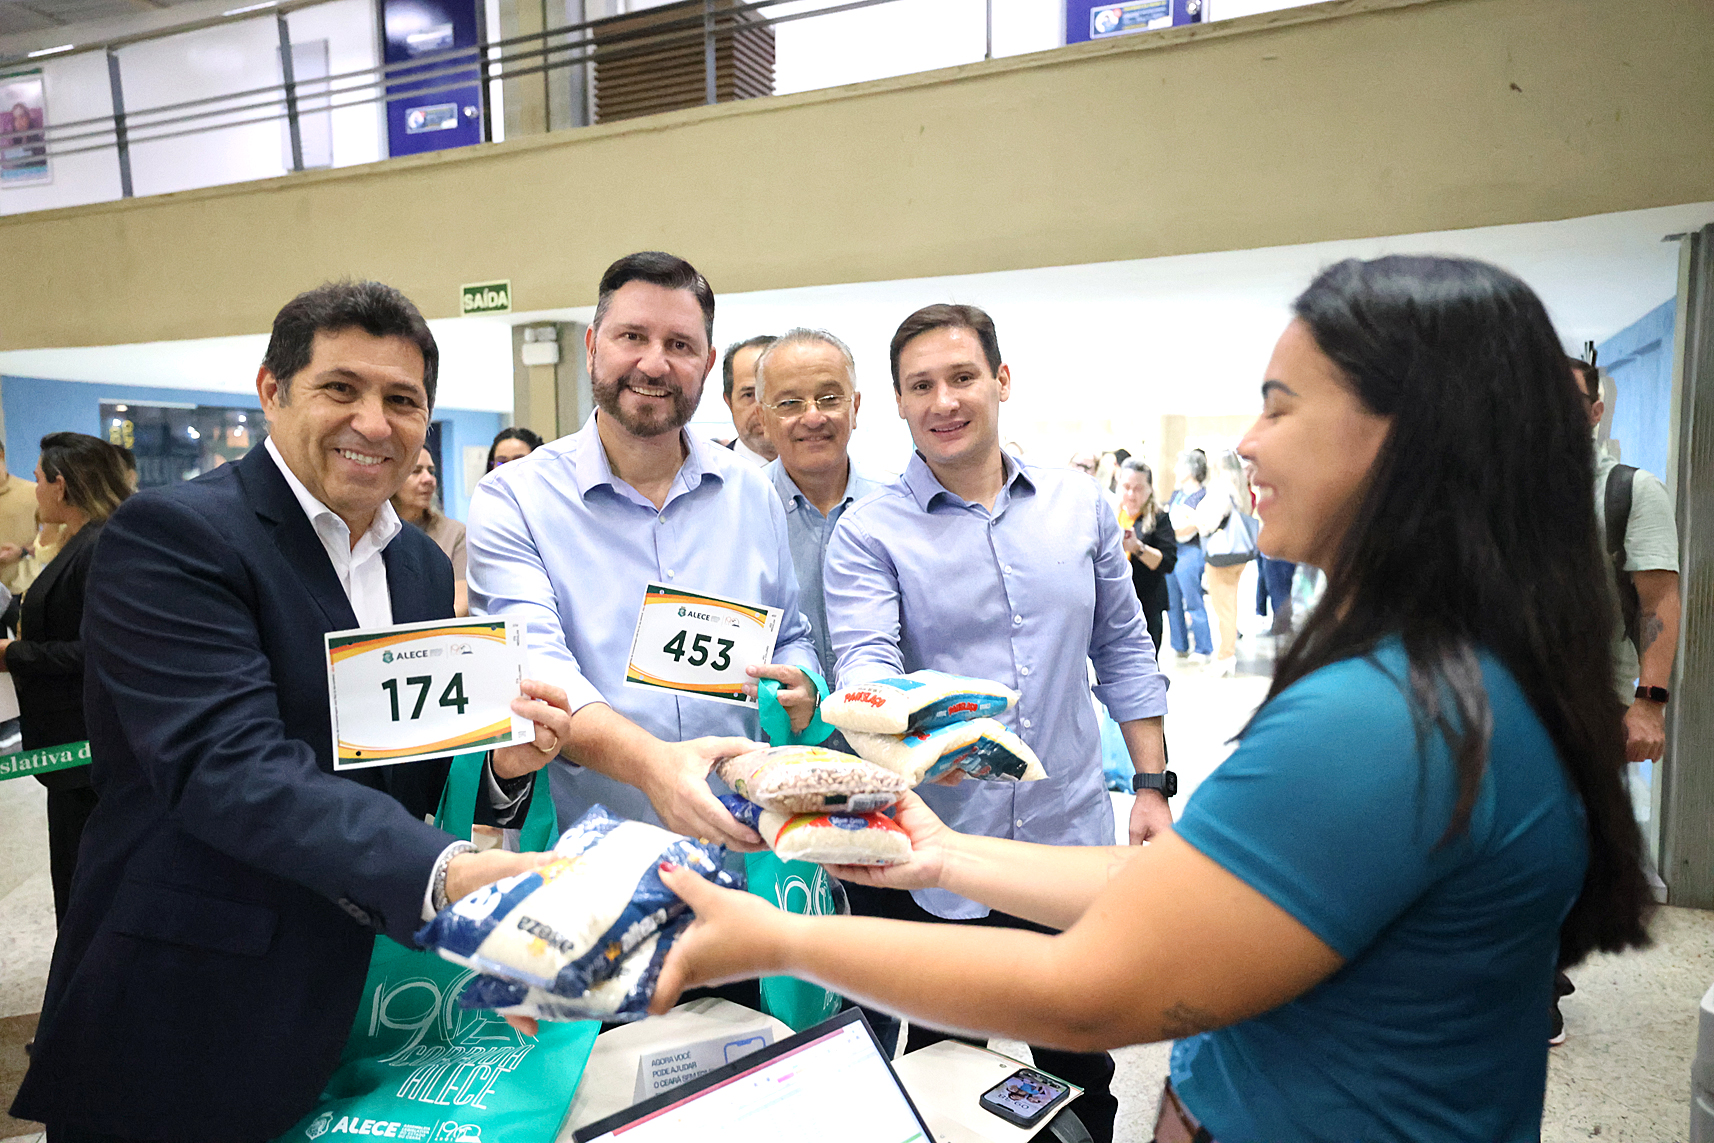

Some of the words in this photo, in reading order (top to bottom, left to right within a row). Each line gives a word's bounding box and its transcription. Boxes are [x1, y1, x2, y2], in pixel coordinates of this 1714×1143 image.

[464, 287, 508, 310] SAÍDA
[687, 610, 711, 622] ALECE
[396, 649, 429, 661] ALECE
[663, 629, 735, 671] 453
[381, 672, 469, 722] 174
[651, 1056, 674, 1067] AGORA
[652, 1068, 670, 1078] PODE
[670, 1061, 698, 1074] AJUDAR
[396, 1063, 512, 1110] ALECE
[653, 1081, 659, 1089] O
[332, 1116, 401, 1138] ALECE
